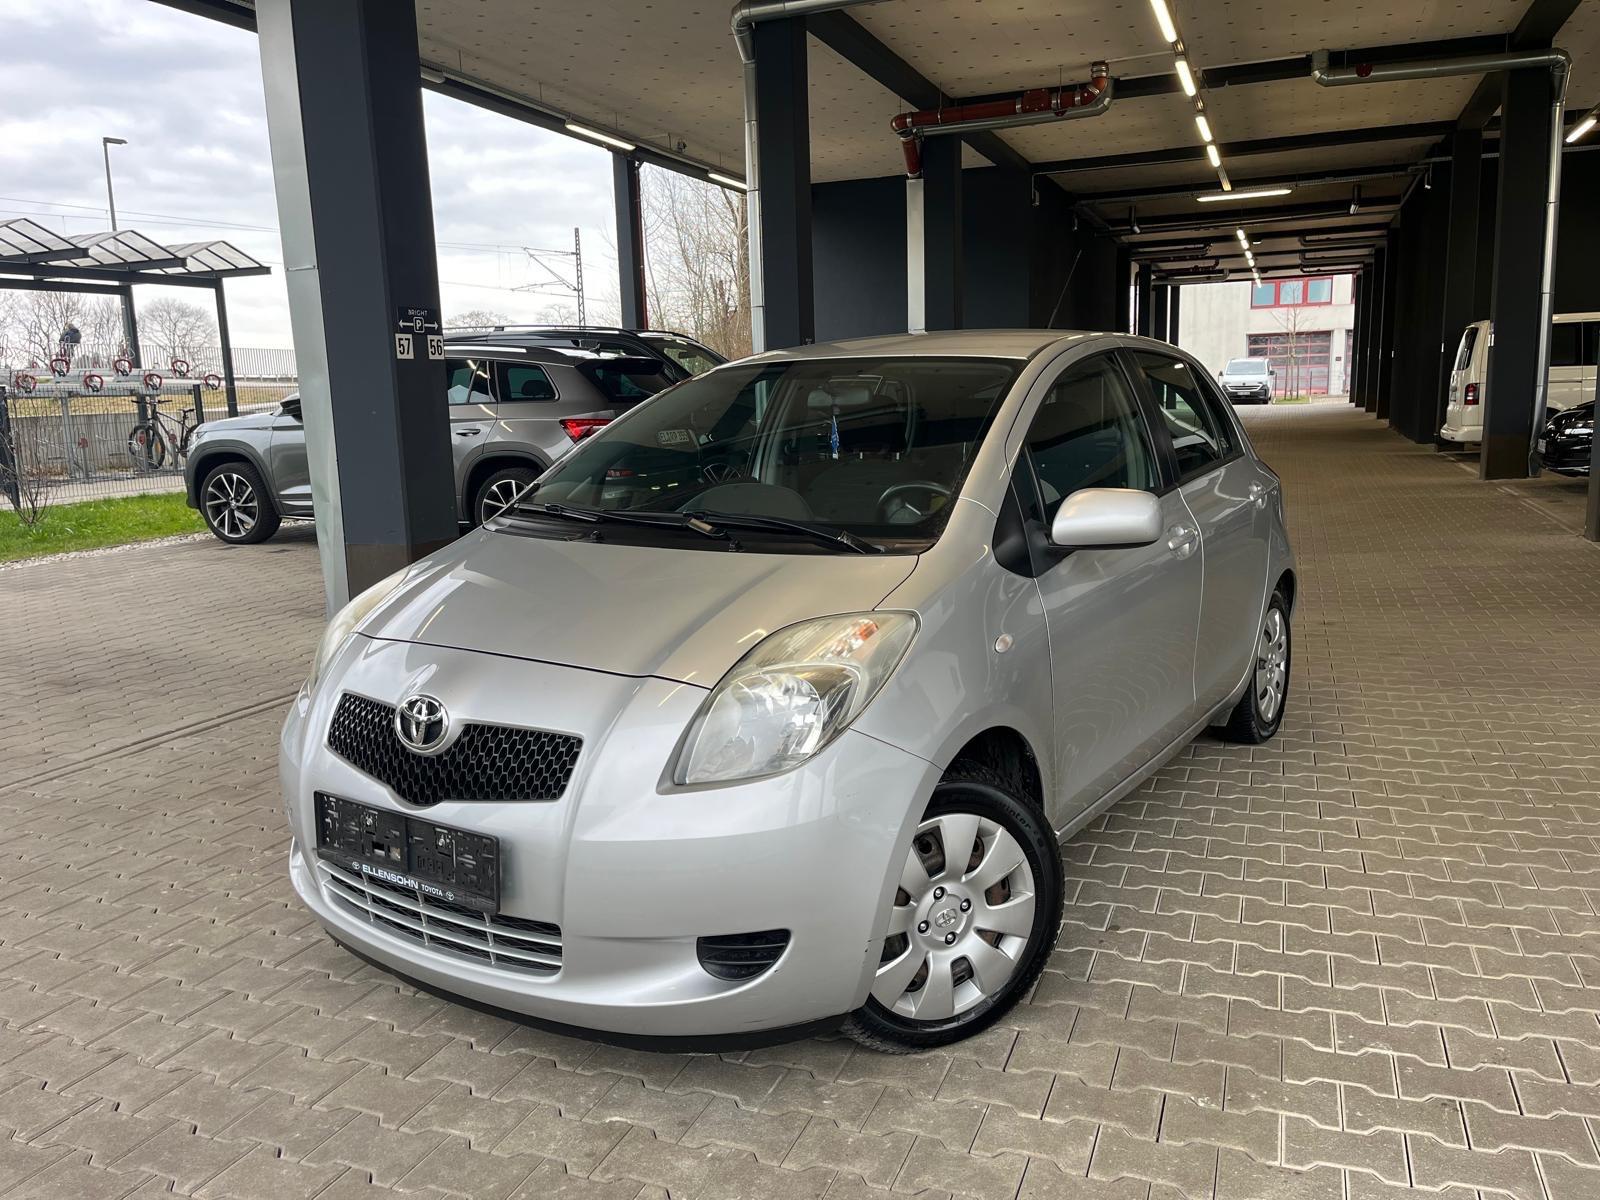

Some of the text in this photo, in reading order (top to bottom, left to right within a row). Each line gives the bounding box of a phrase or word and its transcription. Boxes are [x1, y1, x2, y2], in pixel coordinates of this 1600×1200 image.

[397, 337, 411, 355] 57
[429, 338, 443, 356] 56
[362, 864, 419, 889] ELLENSOHN
[421, 883, 443, 897] TOYOTA
